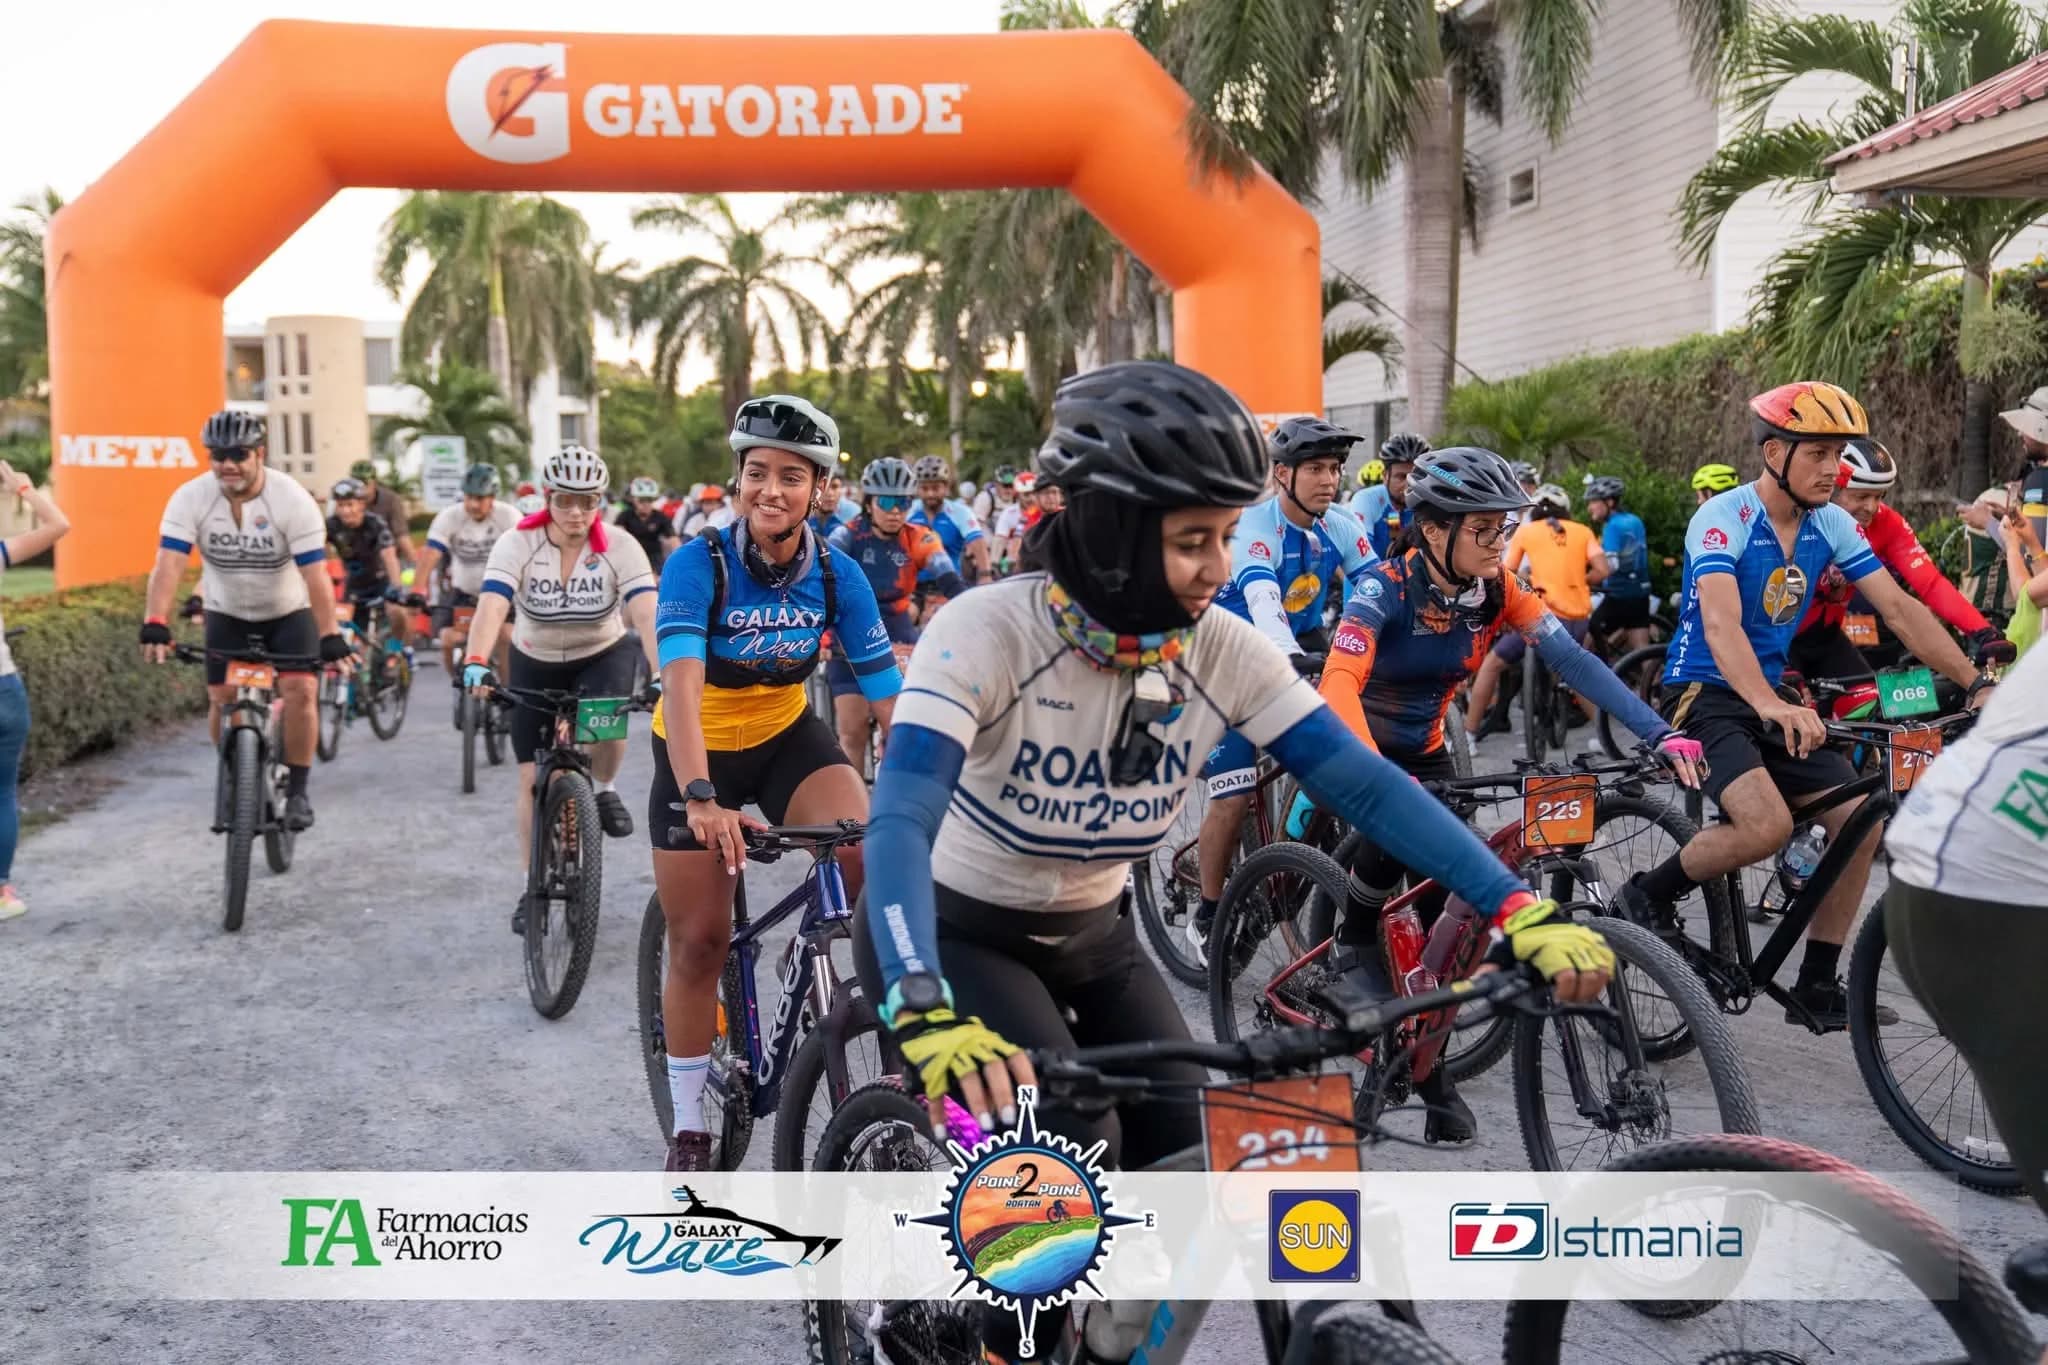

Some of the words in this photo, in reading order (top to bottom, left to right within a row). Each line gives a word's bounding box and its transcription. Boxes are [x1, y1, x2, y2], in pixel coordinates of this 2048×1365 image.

[446, 42, 571, 164] G
[583, 82, 964, 138] GATORADE
[59, 434, 199, 469] META
[208, 532, 275, 549] ROATAN
[528, 576, 604, 595] ROATAN
[726, 606, 824, 630] GALAXY
[728, 628, 816, 658] Wave
[1892, 686, 1928, 702] 066
[588, 715, 620, 728] 087
[1537, 800, 1582, 821] 225
[1237, 1125, 1330, 1169] 234
